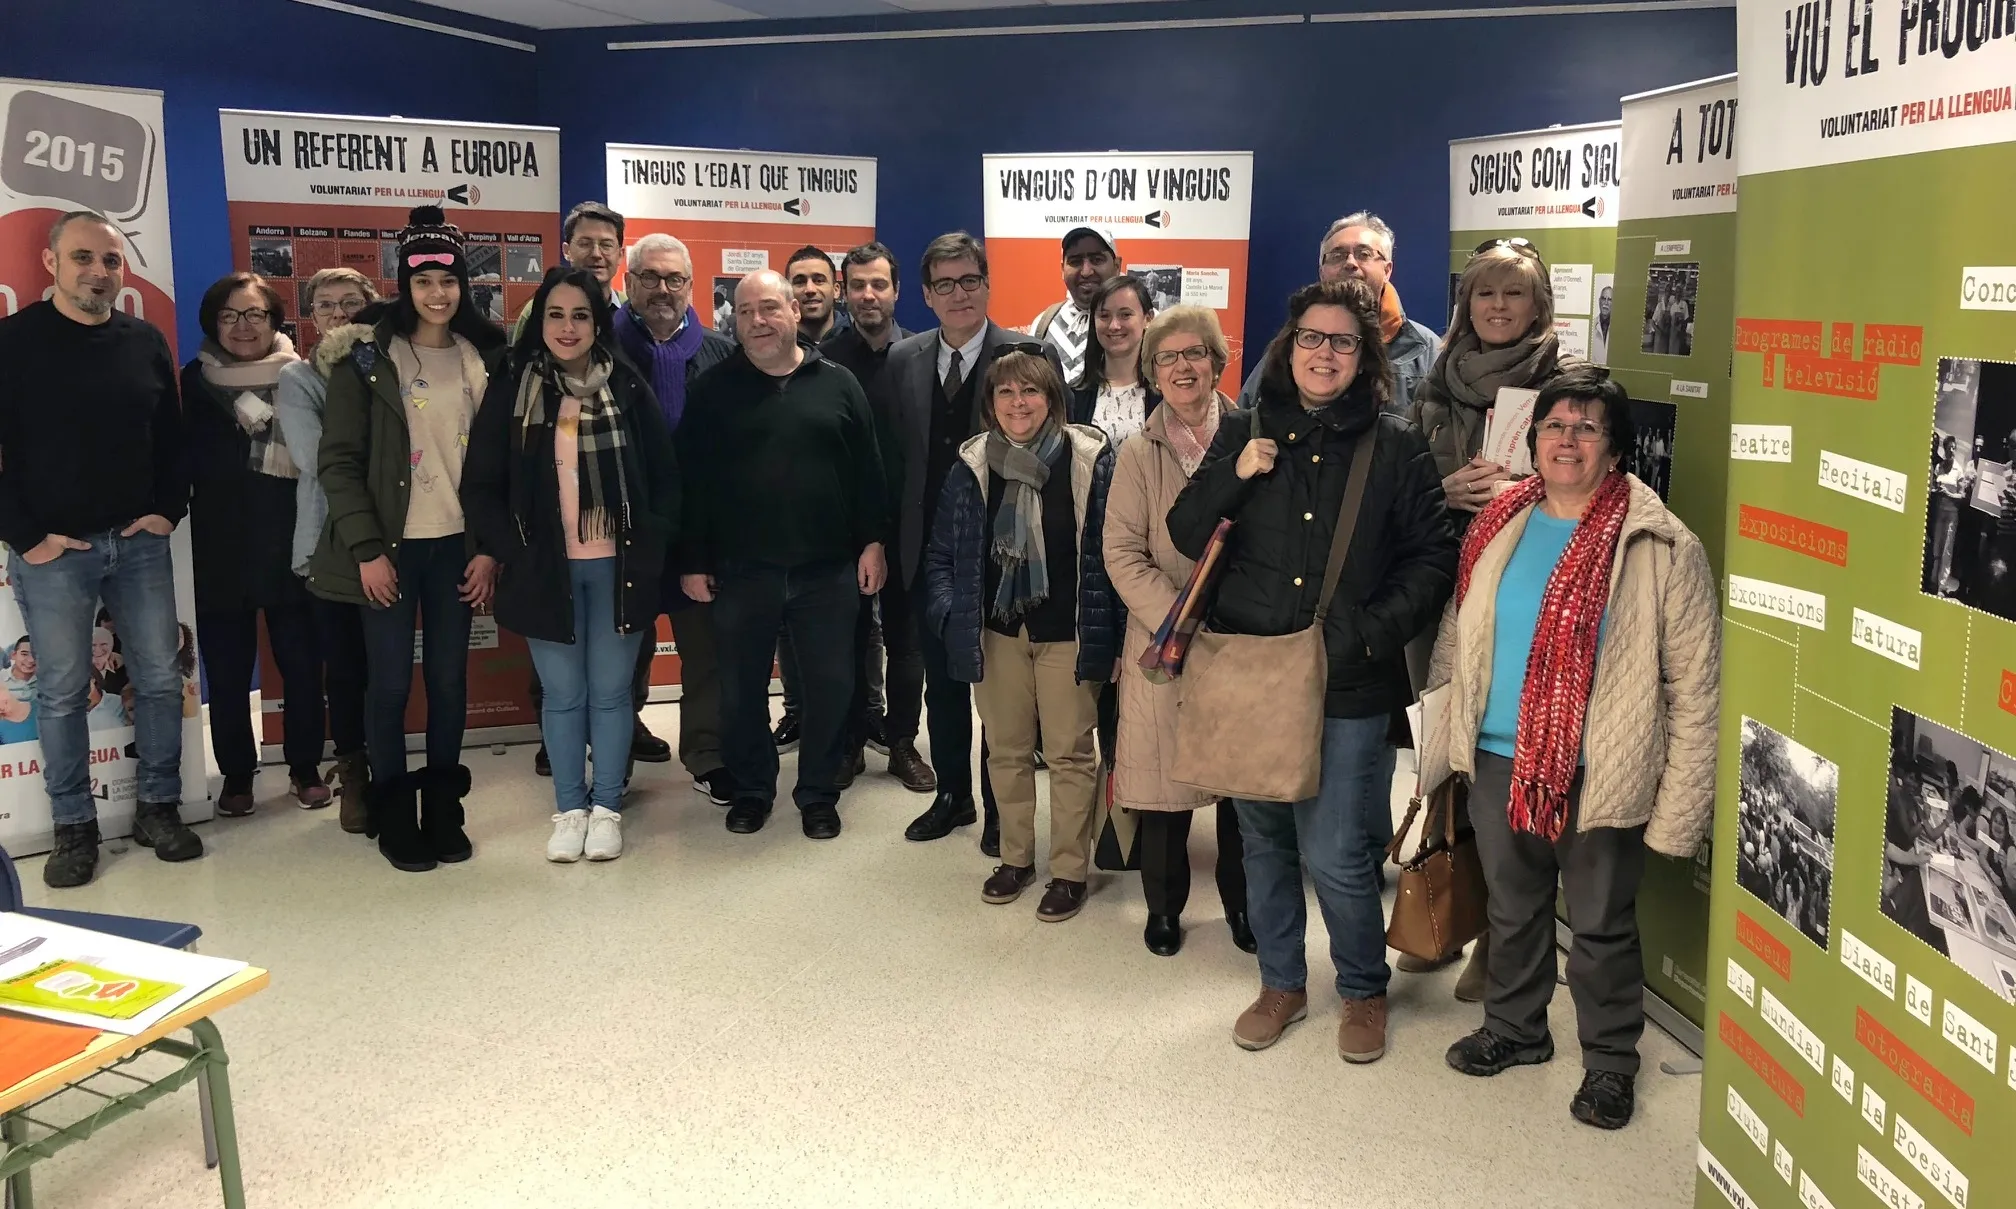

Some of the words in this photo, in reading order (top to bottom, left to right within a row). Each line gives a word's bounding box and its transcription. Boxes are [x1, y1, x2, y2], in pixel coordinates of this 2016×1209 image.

[1785, 0, 1831, 88] VIU
[1845, 0, 1879, 78] EL
[1820, 105, 1898, 139] VOLUNTARIAT
[1900, 101, 1926, 126] PER
[1928, 97, 1944, 121] LA
[1948, 86, 2012, 118] LLENGUA
[23, 130, 125, 182] 2015
[243, 128, 282, 166] UN
[294, 130, 408, 173] REFERENT
[421, 136, 439, 174] A
[451, 139, 539, 178] EUROPA
[1666, 107, 1683, 165] A
[310, 184, 372, 196] VOLUNTARIAT
[374, 187, 392, 197] PER
[394, 188, 406, 198] LA
[407, 188, 446, 199] LLENGUA
[622, 159, 686, 187] TINGUIS
[695, 162, 752, 191] L'EDAT
[760, 164, 789, 193] QUE
[797, 166, 858, 194] TINGUIS
[1000, 168, 1075, 201] VINGUIS
[1085, 168, 1137, 201] D'ON
[1148, 167, 1231, 201] VINGUIS
[1469, 149, 1523, 197] SIGUIS
[1531, 147, 1572, 191] COM
[1672, 184, 1715, 200] VOLUNTARIAT
[1716, 183, 1730, 196] PER
[1731, 182, 1738, 195] L
[674, 198, 723, 208] VOLUNTARIAT
[725, 200, 739, 209] PER
[740, 201, 750, 209] LA
[751, 202, 783, 211] LLENGUA
[1044, 215, 1088, 223] VOLUNTARIAT
[1090, 215, 1103, 223] PER
[1104, 215, 1113, 223] LA
[1114, 215, 1144, 224] LLENGUA
[1498, 206, 1534, 216] VOLUNTARIAT
[1535, 205, 1546, 215] PER
[1546, 205, 1554, 214] LA
[1555, 204, 1581, 214] LLENGUA
[255, 227, 285, 235] Andorra
[299, 228, 328, 237] Bolzano
[343, 229, 371, 238] Flandes
[468, 233, 497, 243] Perpinyà
[1735, 325, 1821, 352] Programes
[1832, 331, 1852, 353] de
[1863, 330, 1921, 359] ràdio
[1764, 361, 1773, 382] i
[1785, 363, 1878, 395] televisió
[1732, 432, 1791, 456] Teatre
[1820, 459, 1905, 506] Recitals
[1739, 511, 1847, 561] Exposicions
[1730, 581, 1824, 624] Excursions
[1853, 616, 1919, 664] Natura
[18, 760, 40, 777] LA
[1737, 919, 1789, 974] Museus
[1841, 937, 1895, 994] Diada
[1907, 985, 1931, 1018] de
[1945, 1011, 1995, 1064] Sant
[1719, 1022, 1804, 1114] Literatura
[1727, 965, 1753, 1001] Dia
[1761, 995, 1823, 1068] Mundial
[1833, 1065, 1852, 1096] de
[1863, 1090, 1883, 1129] la
[1894, 1121, 1966, 1208] Poesia
[1856, 1015, 1973, 1131] Fotografia
[1728, 1092, 1768, 1149] Clubs
[1775, 1149, 1792, 1178] de
[1858, 1153, 1924, 1209] Marat
